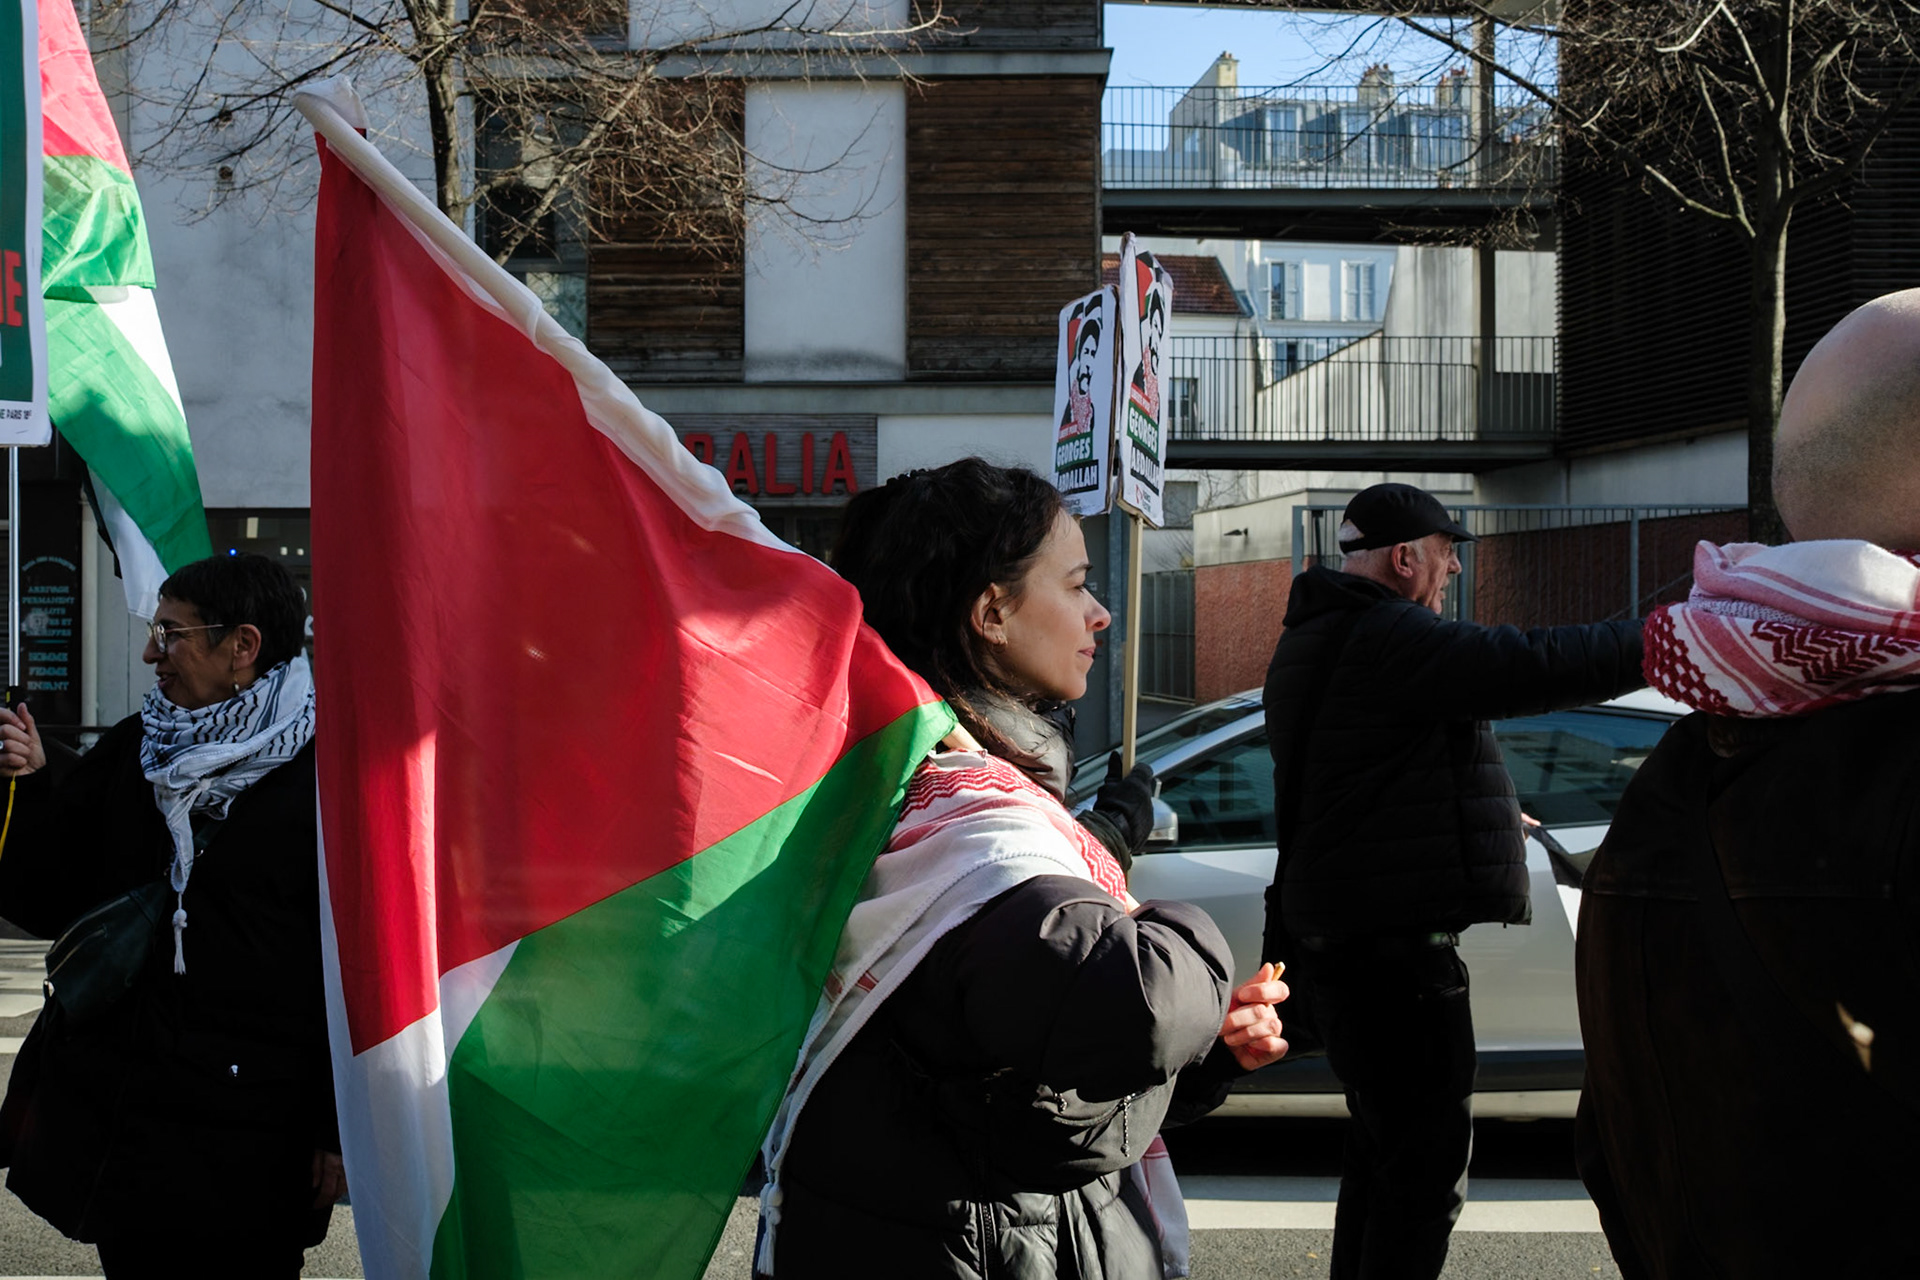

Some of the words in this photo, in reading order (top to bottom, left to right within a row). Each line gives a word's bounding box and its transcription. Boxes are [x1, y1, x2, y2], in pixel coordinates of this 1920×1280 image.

[1128, 406, 1158, 454] GEORGES
[1056, 437, 1091, 468] GEORGES
[1059, 464, 1098, 493] ABDALLAH
[28, 585, 70, 594] ARRIVAGE
[22, 597, 75, 605] PERMANENT
[28, 652, 69, 662] HOMME
[28, 667, 68, 677] FEMME
[27, 681, 70, 691] ENFANT
